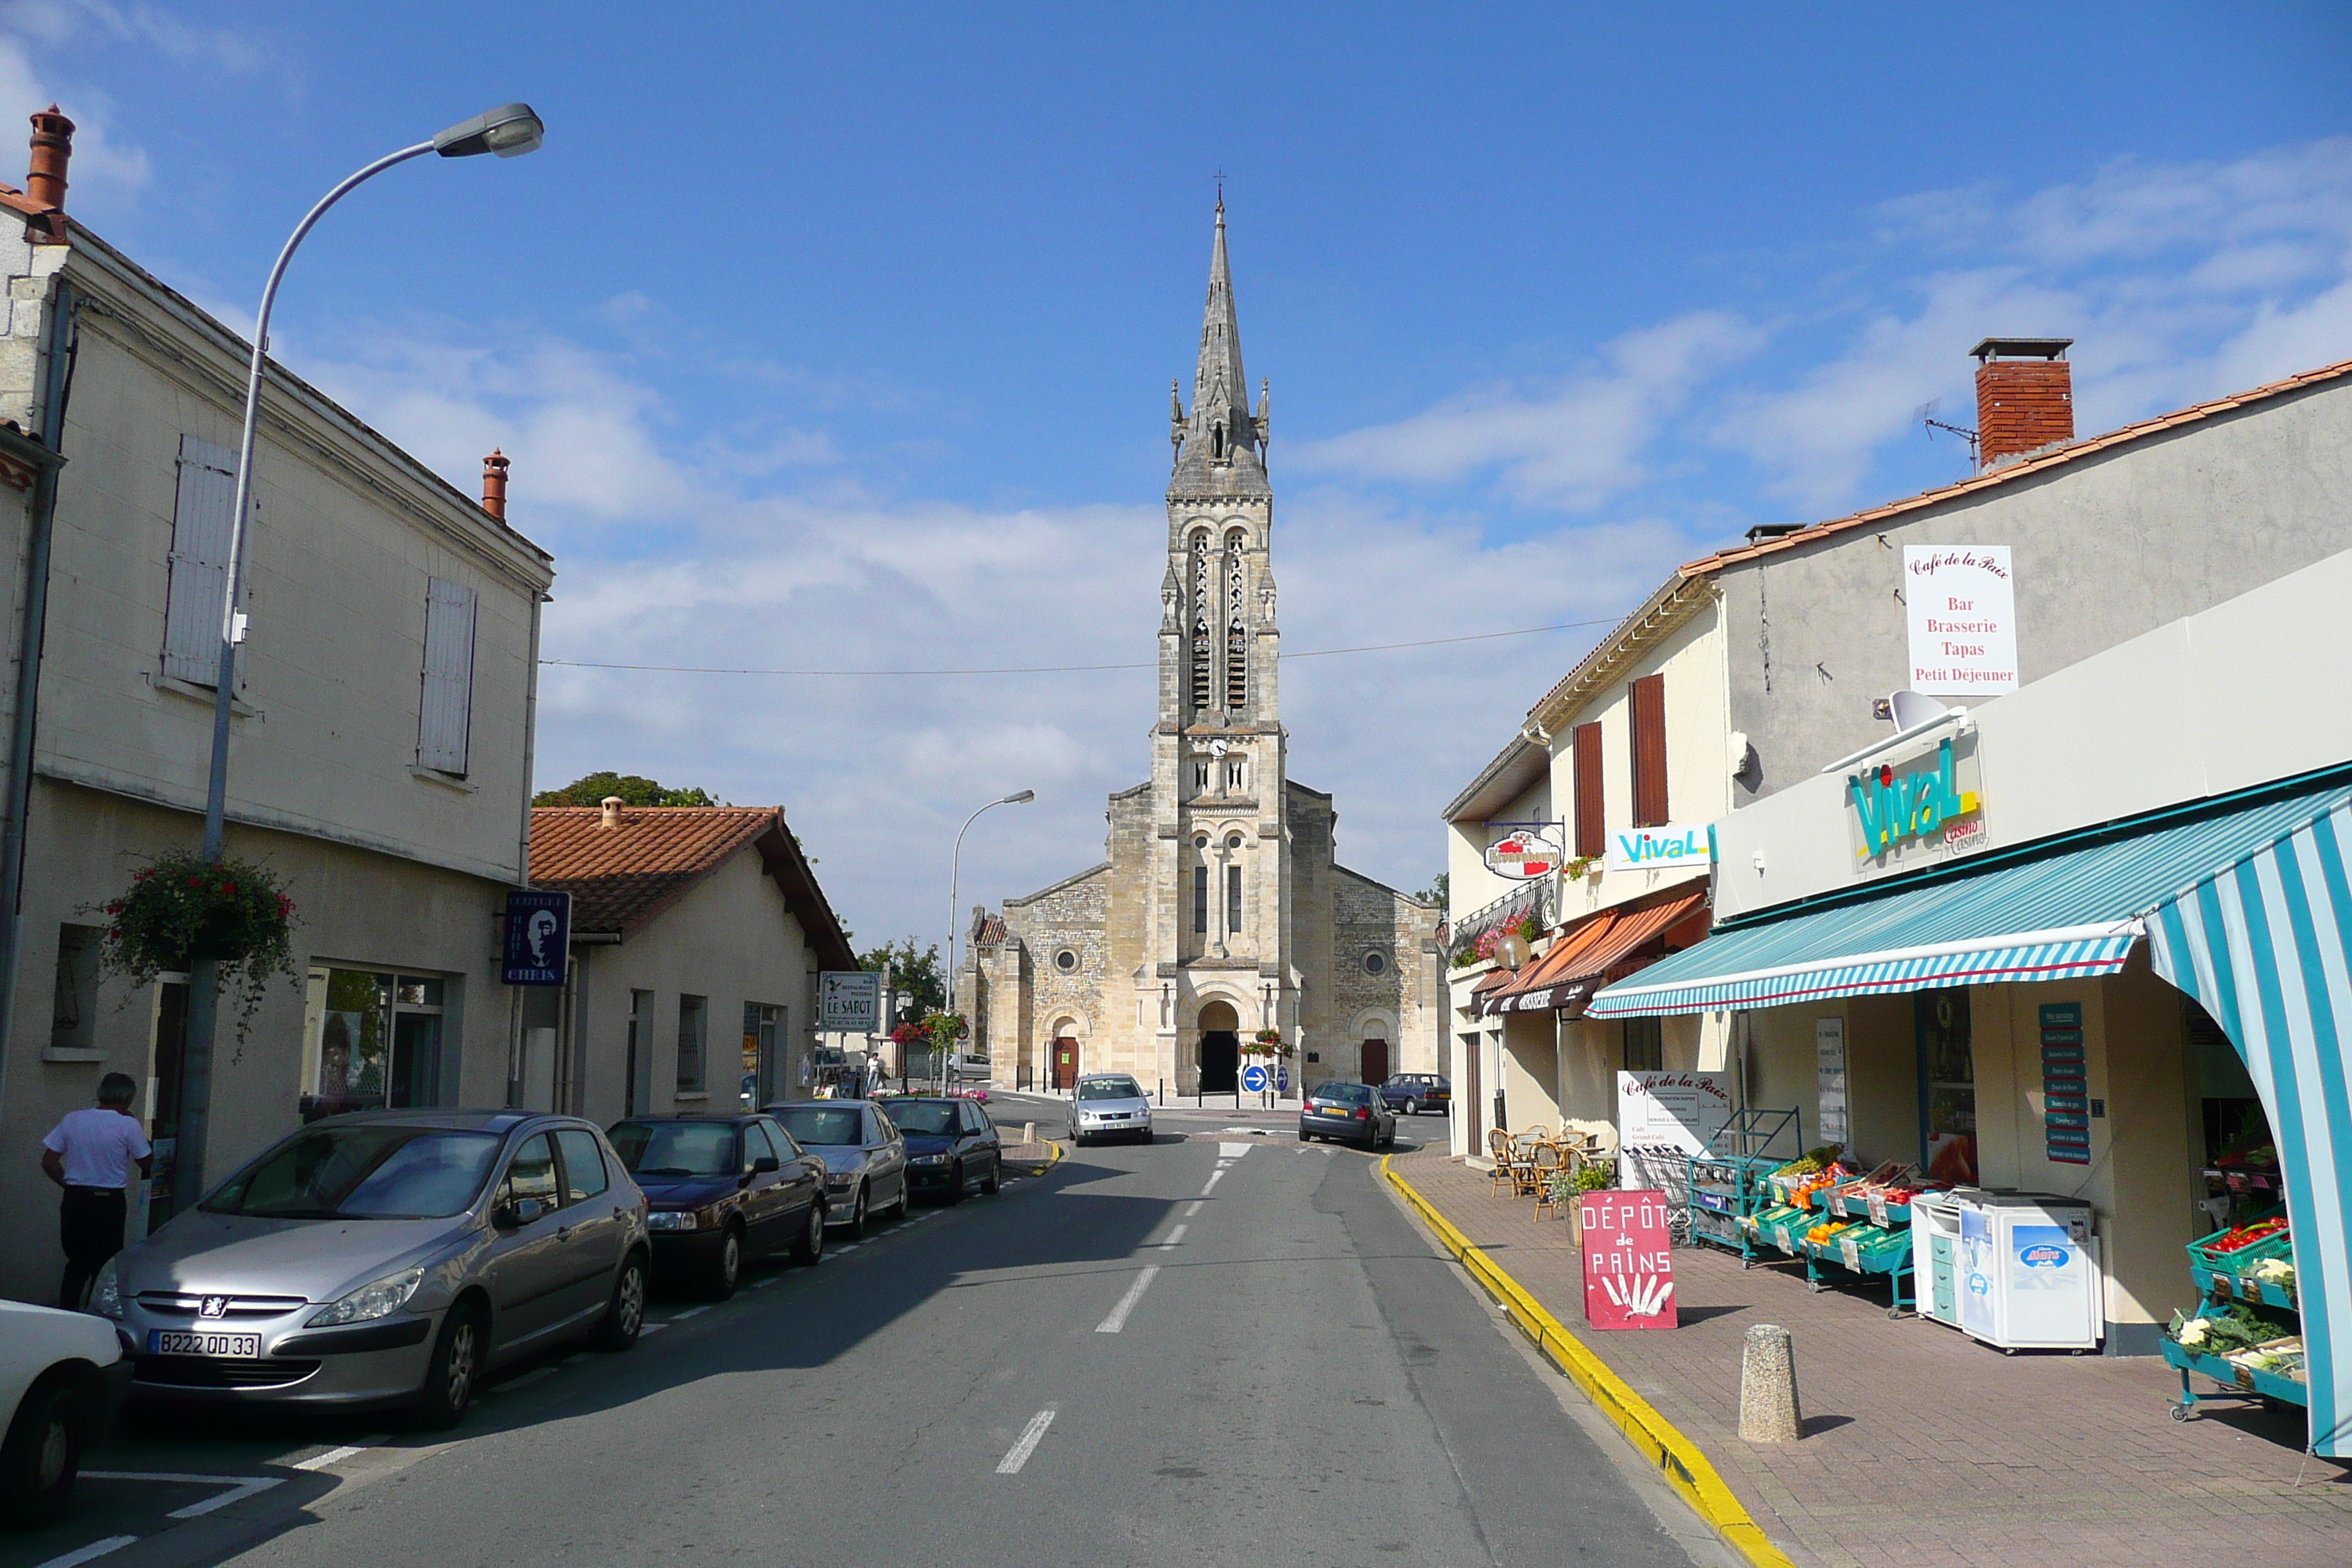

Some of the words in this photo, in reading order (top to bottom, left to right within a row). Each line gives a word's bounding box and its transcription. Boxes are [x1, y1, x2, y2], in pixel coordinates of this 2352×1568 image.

[1909, 553, 1942, 576] Café
[1944, 552, 1960, 565] de
[1962, 551, 1976, 566] la
[1978, 556, 2008, 579] Paix
[1948, 597, 1974, 611] Bar
[1926, 619, 1997, 633] Brasserie
[1941, 641, 1985, 658] Tapas
[1915, 668, 1948, 681] Petit
[1952, 668, 2014, 683] Déjeuner
[1944, 820, 1978, 844] Casino
[1488, 848, 1558, 866] Kronenbourg
[508, 969, 555, 981] CHRIS
[828, 1002, 838, 1014] LE
[841, 1000, 872, 1014] SABOT
[1622, 1075, 1656, 1096] Café
[1659, 1074, 1676, 1087] de
[1678, 1074, 1693, 1087] la
[1695, 1077, 1728, 1100] Paix
[1581, 1196, 1667, 1229] DÉPÔT
[1616, 1232, 1634, 1246] de
[2027, 1250, 2060, 1261] Mars
[161, 1334, 203, 1354] 8222
[207, 1336, 229, 1354] QD
[233, 1337, 255, 1355] 33
